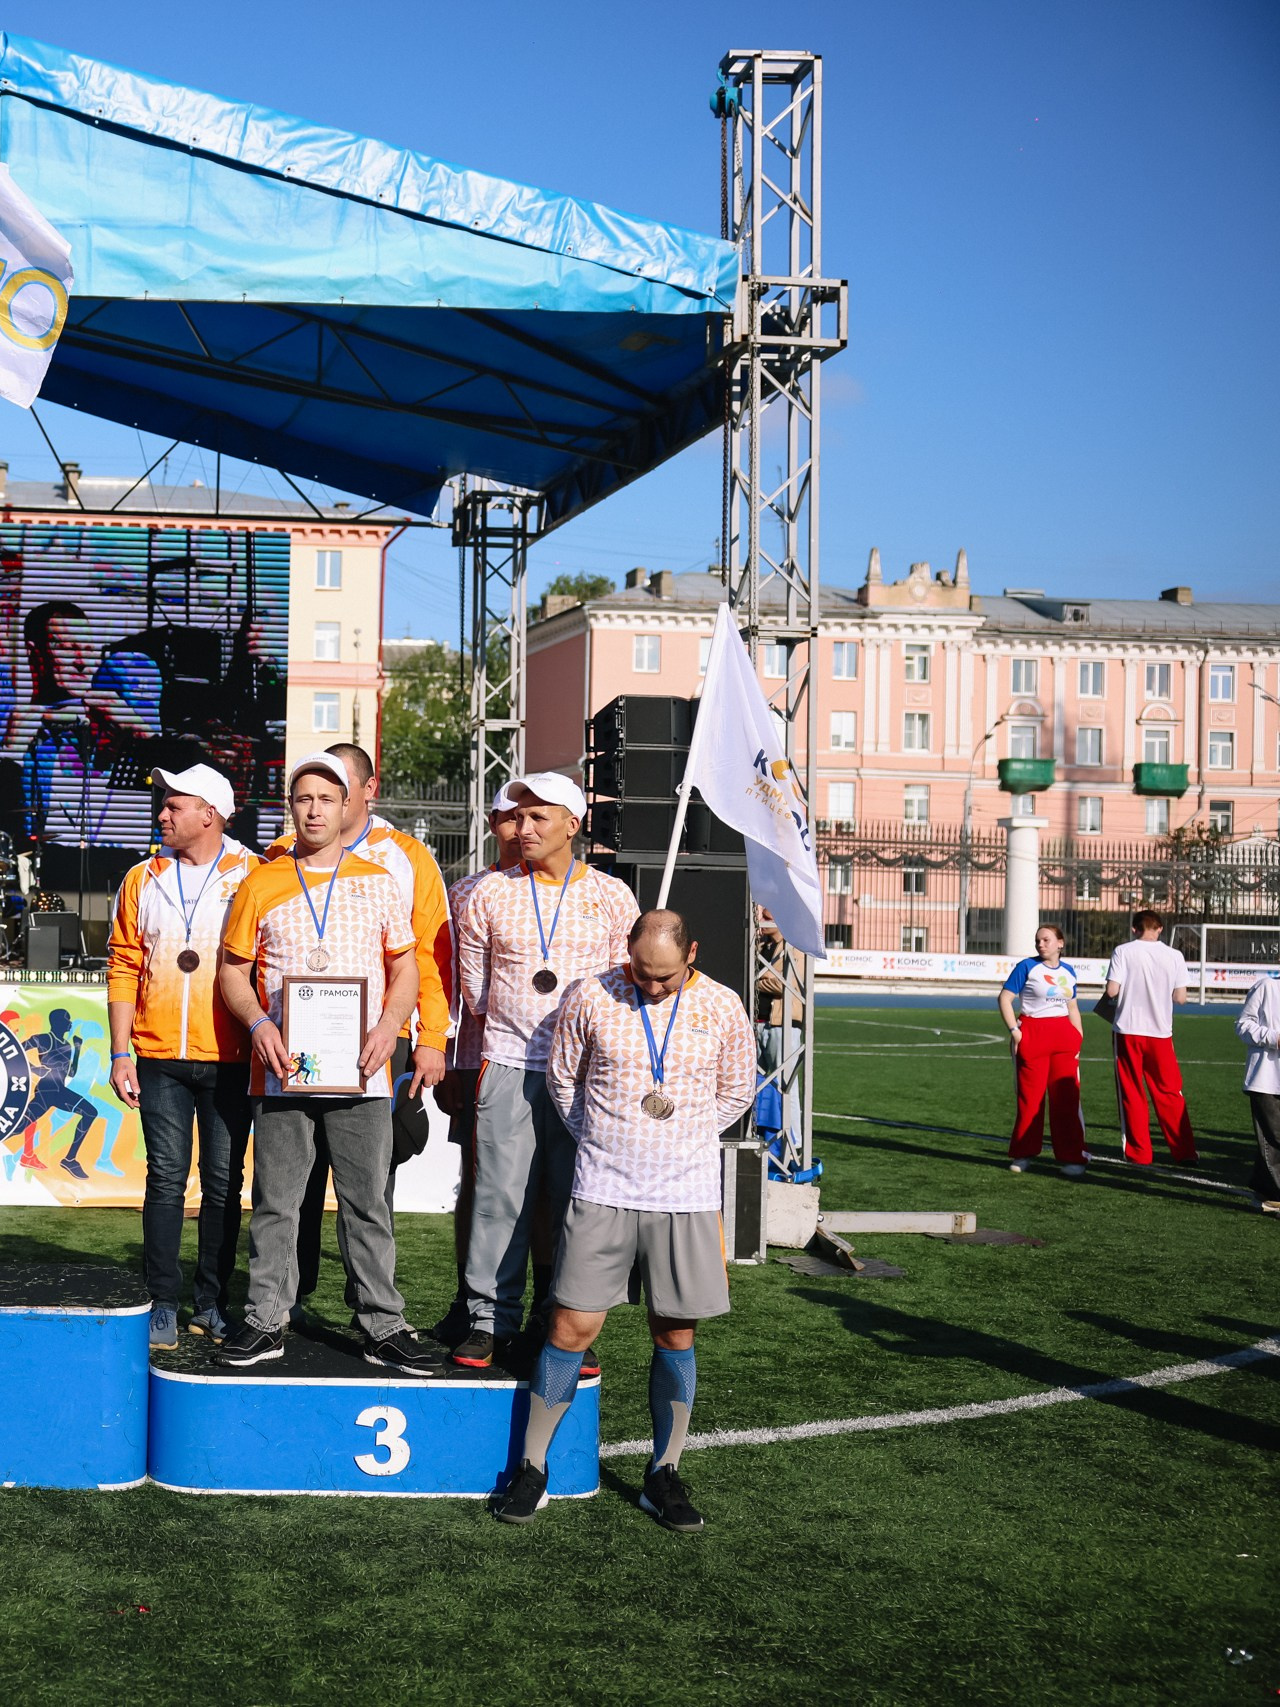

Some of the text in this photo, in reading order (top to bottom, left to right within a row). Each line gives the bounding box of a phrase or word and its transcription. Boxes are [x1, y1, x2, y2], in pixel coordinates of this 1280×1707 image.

[897, 957, 934, 967] КОМОС
[319, 989, 359, 998] ГРАМОТА
[354, 1405, 411, 1476] 3
